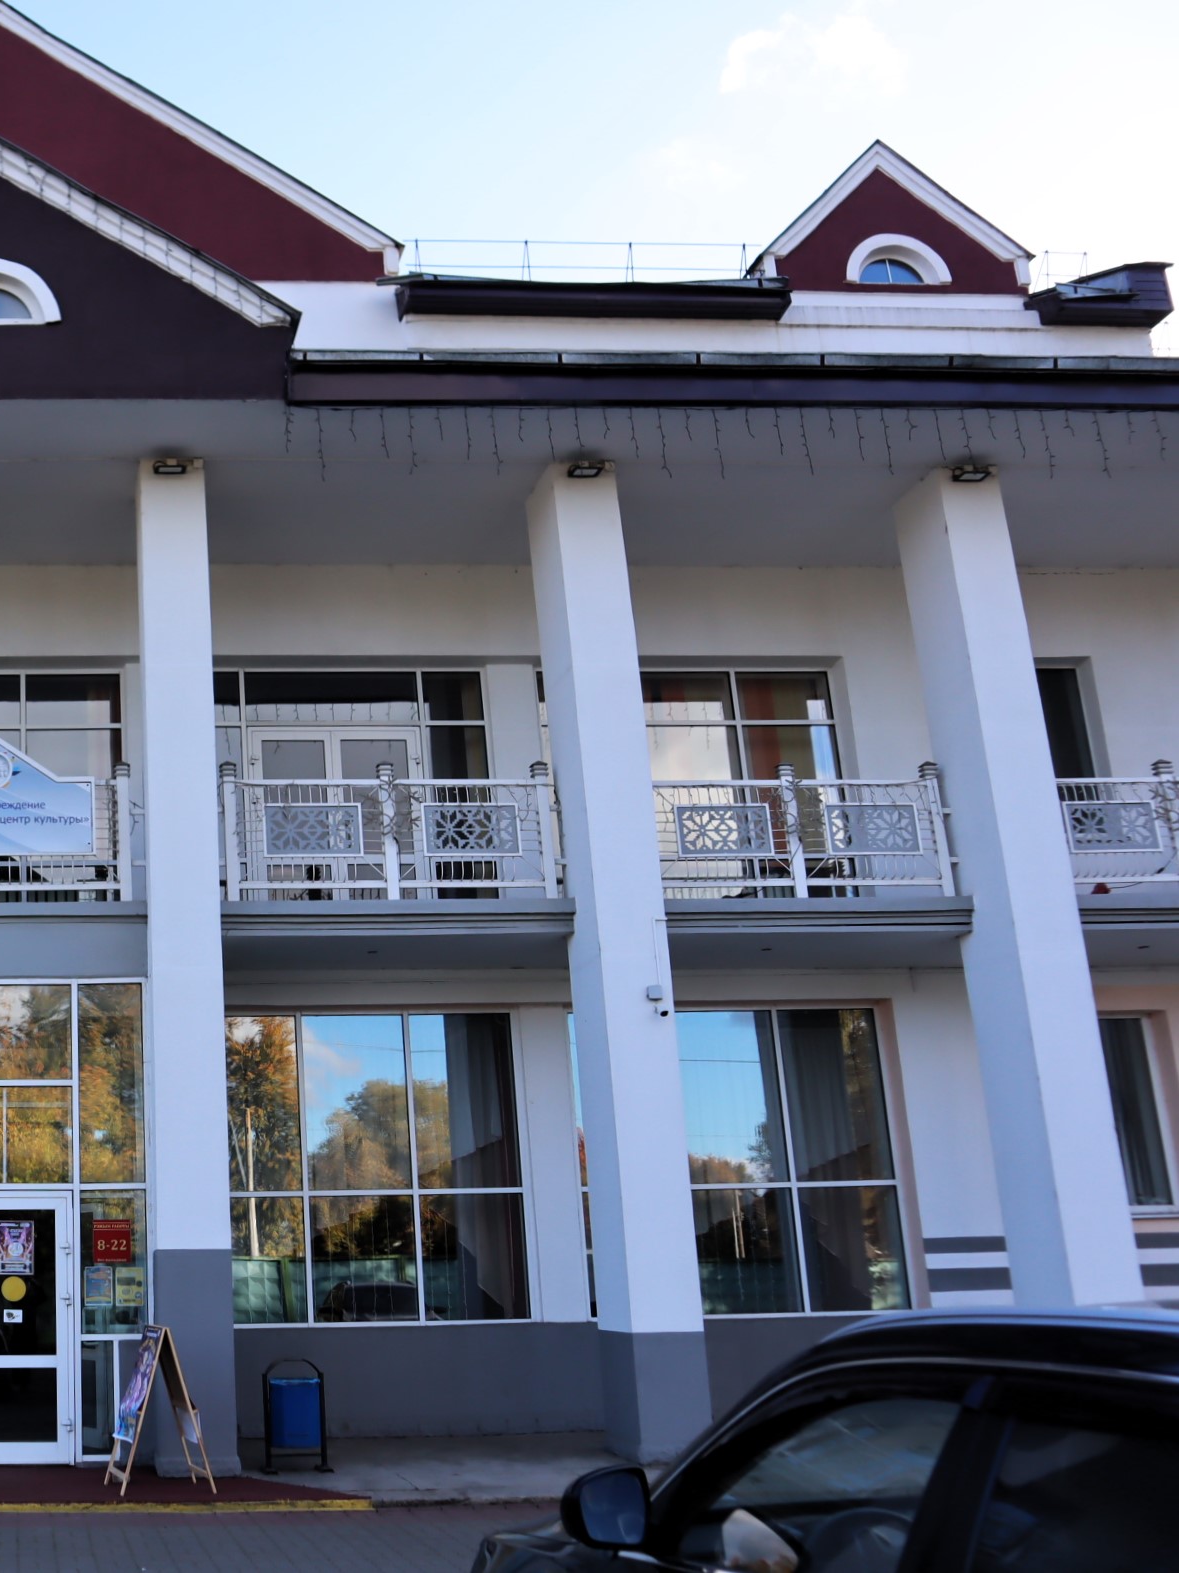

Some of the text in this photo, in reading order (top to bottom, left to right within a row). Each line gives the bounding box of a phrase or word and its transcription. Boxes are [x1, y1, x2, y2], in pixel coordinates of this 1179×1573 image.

[0, 815, 31, 825] центр
[34, 815, 90, 825] культуры»
[97, 1239, 127, 1251] 8-22
